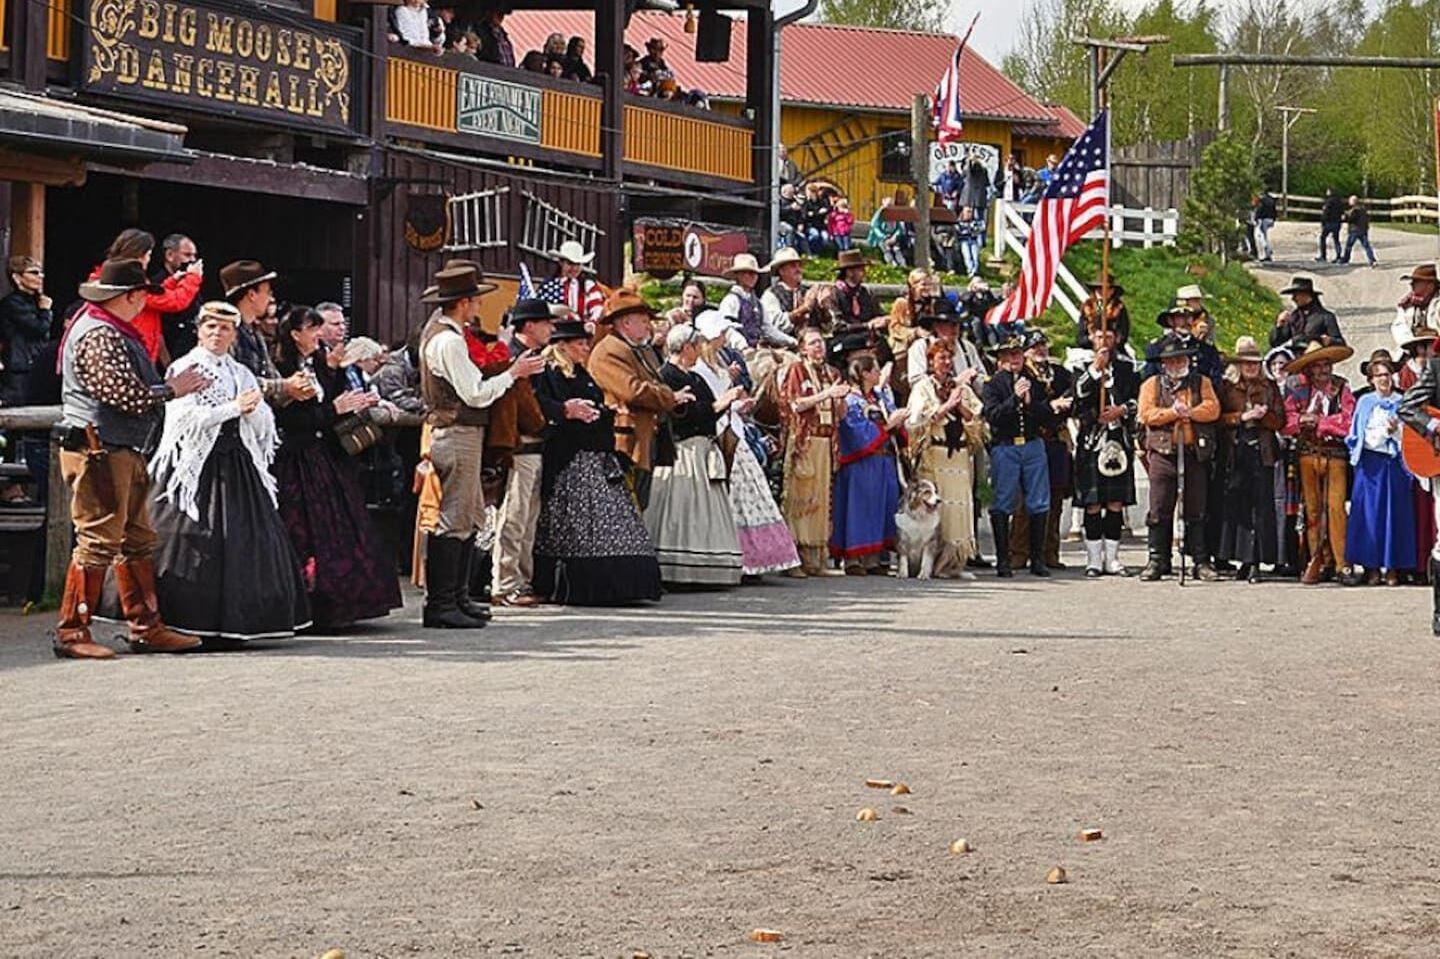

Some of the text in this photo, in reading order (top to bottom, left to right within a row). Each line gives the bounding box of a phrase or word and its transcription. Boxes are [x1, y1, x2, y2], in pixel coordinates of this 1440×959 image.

[205, 12, 312, 70] MOOSE
[117, 42, 324, 118] DANCEHALL
[934, 144, 959, 160] OLD
[646, 228, 682, 248] COLD
